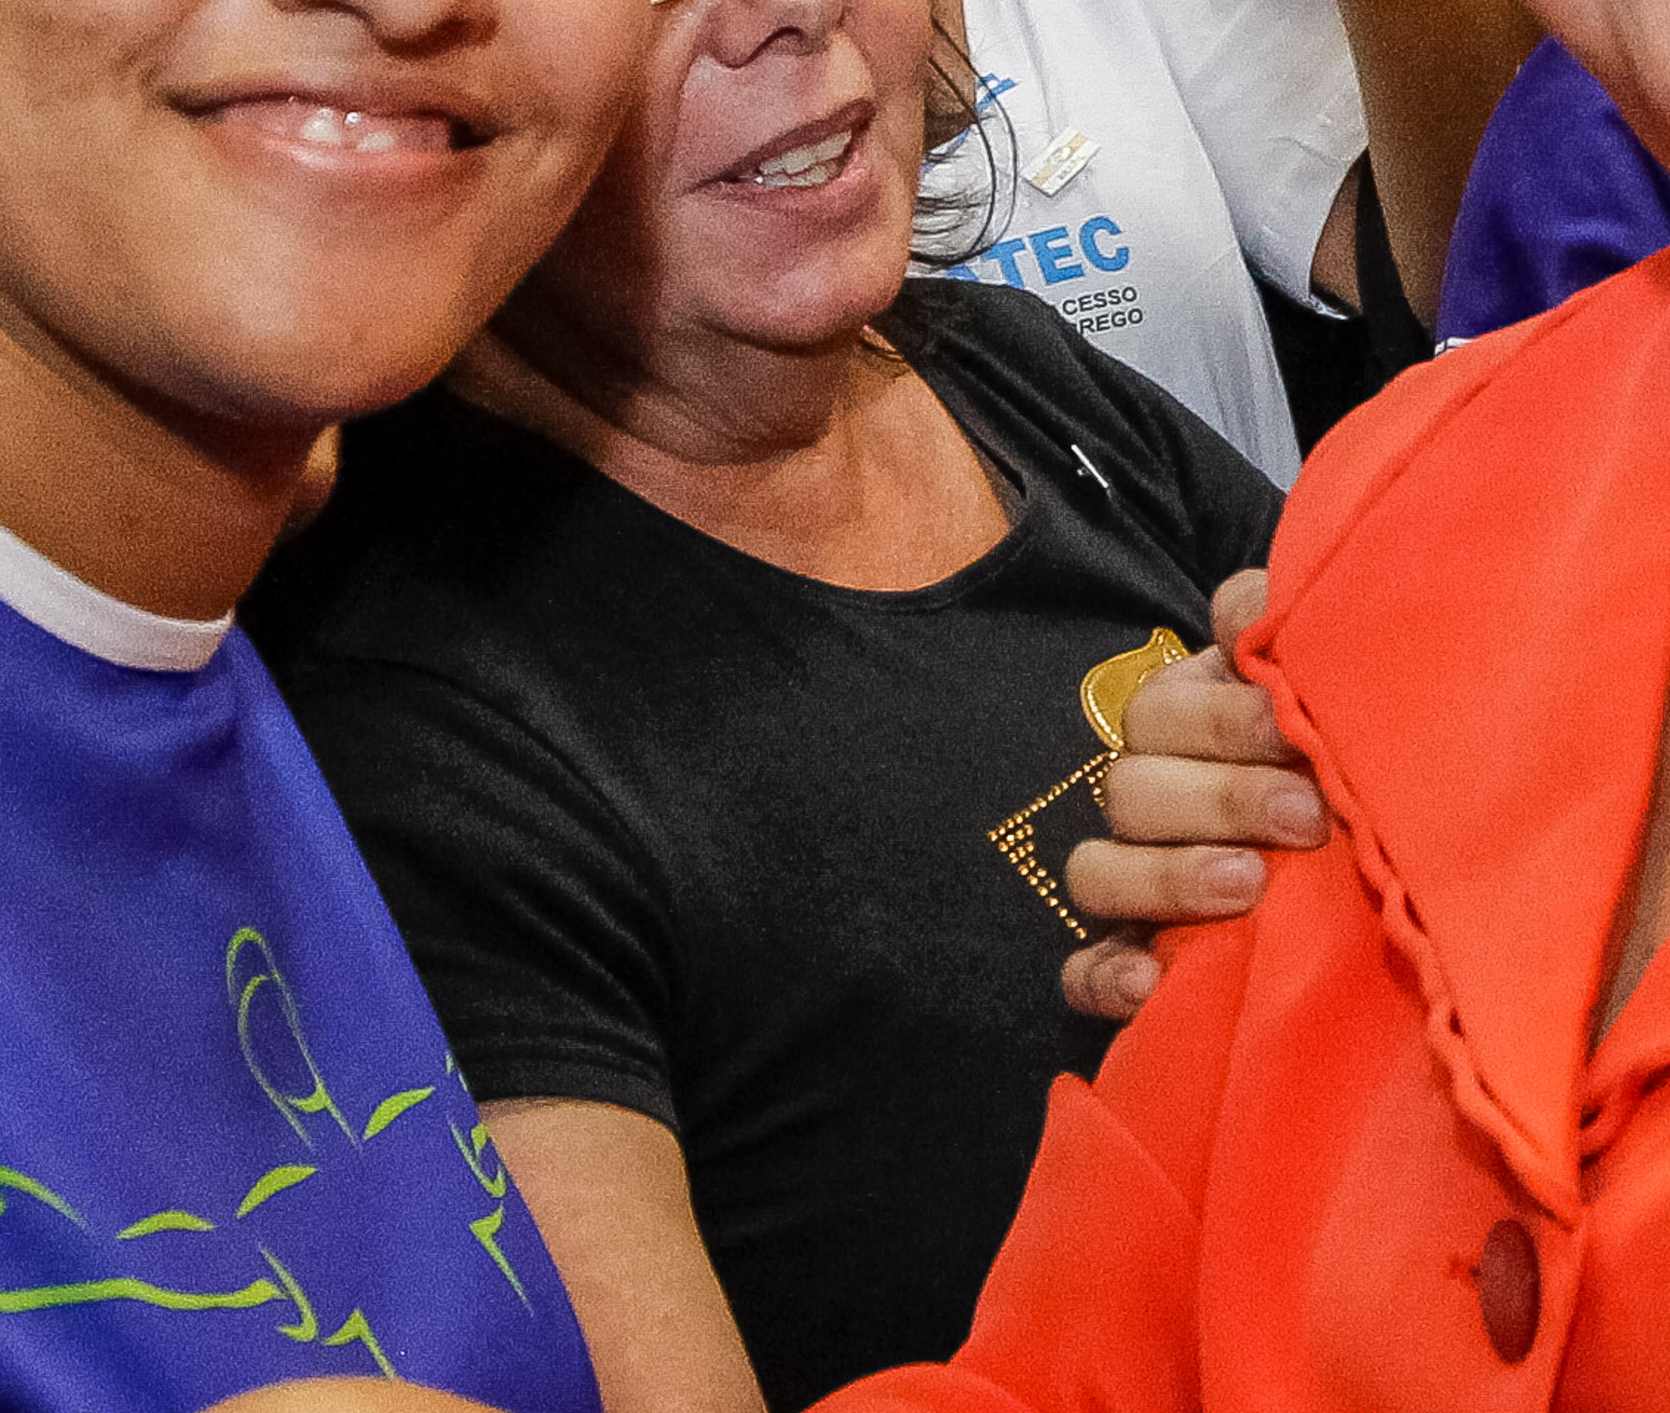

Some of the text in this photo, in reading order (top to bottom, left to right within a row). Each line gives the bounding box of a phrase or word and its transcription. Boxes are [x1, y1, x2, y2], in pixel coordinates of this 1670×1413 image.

[944, 215, 1130, 290] TEC
[1061, 286, 1138, 316] CESSO
[1078, 307, 1144, 335] REGO
